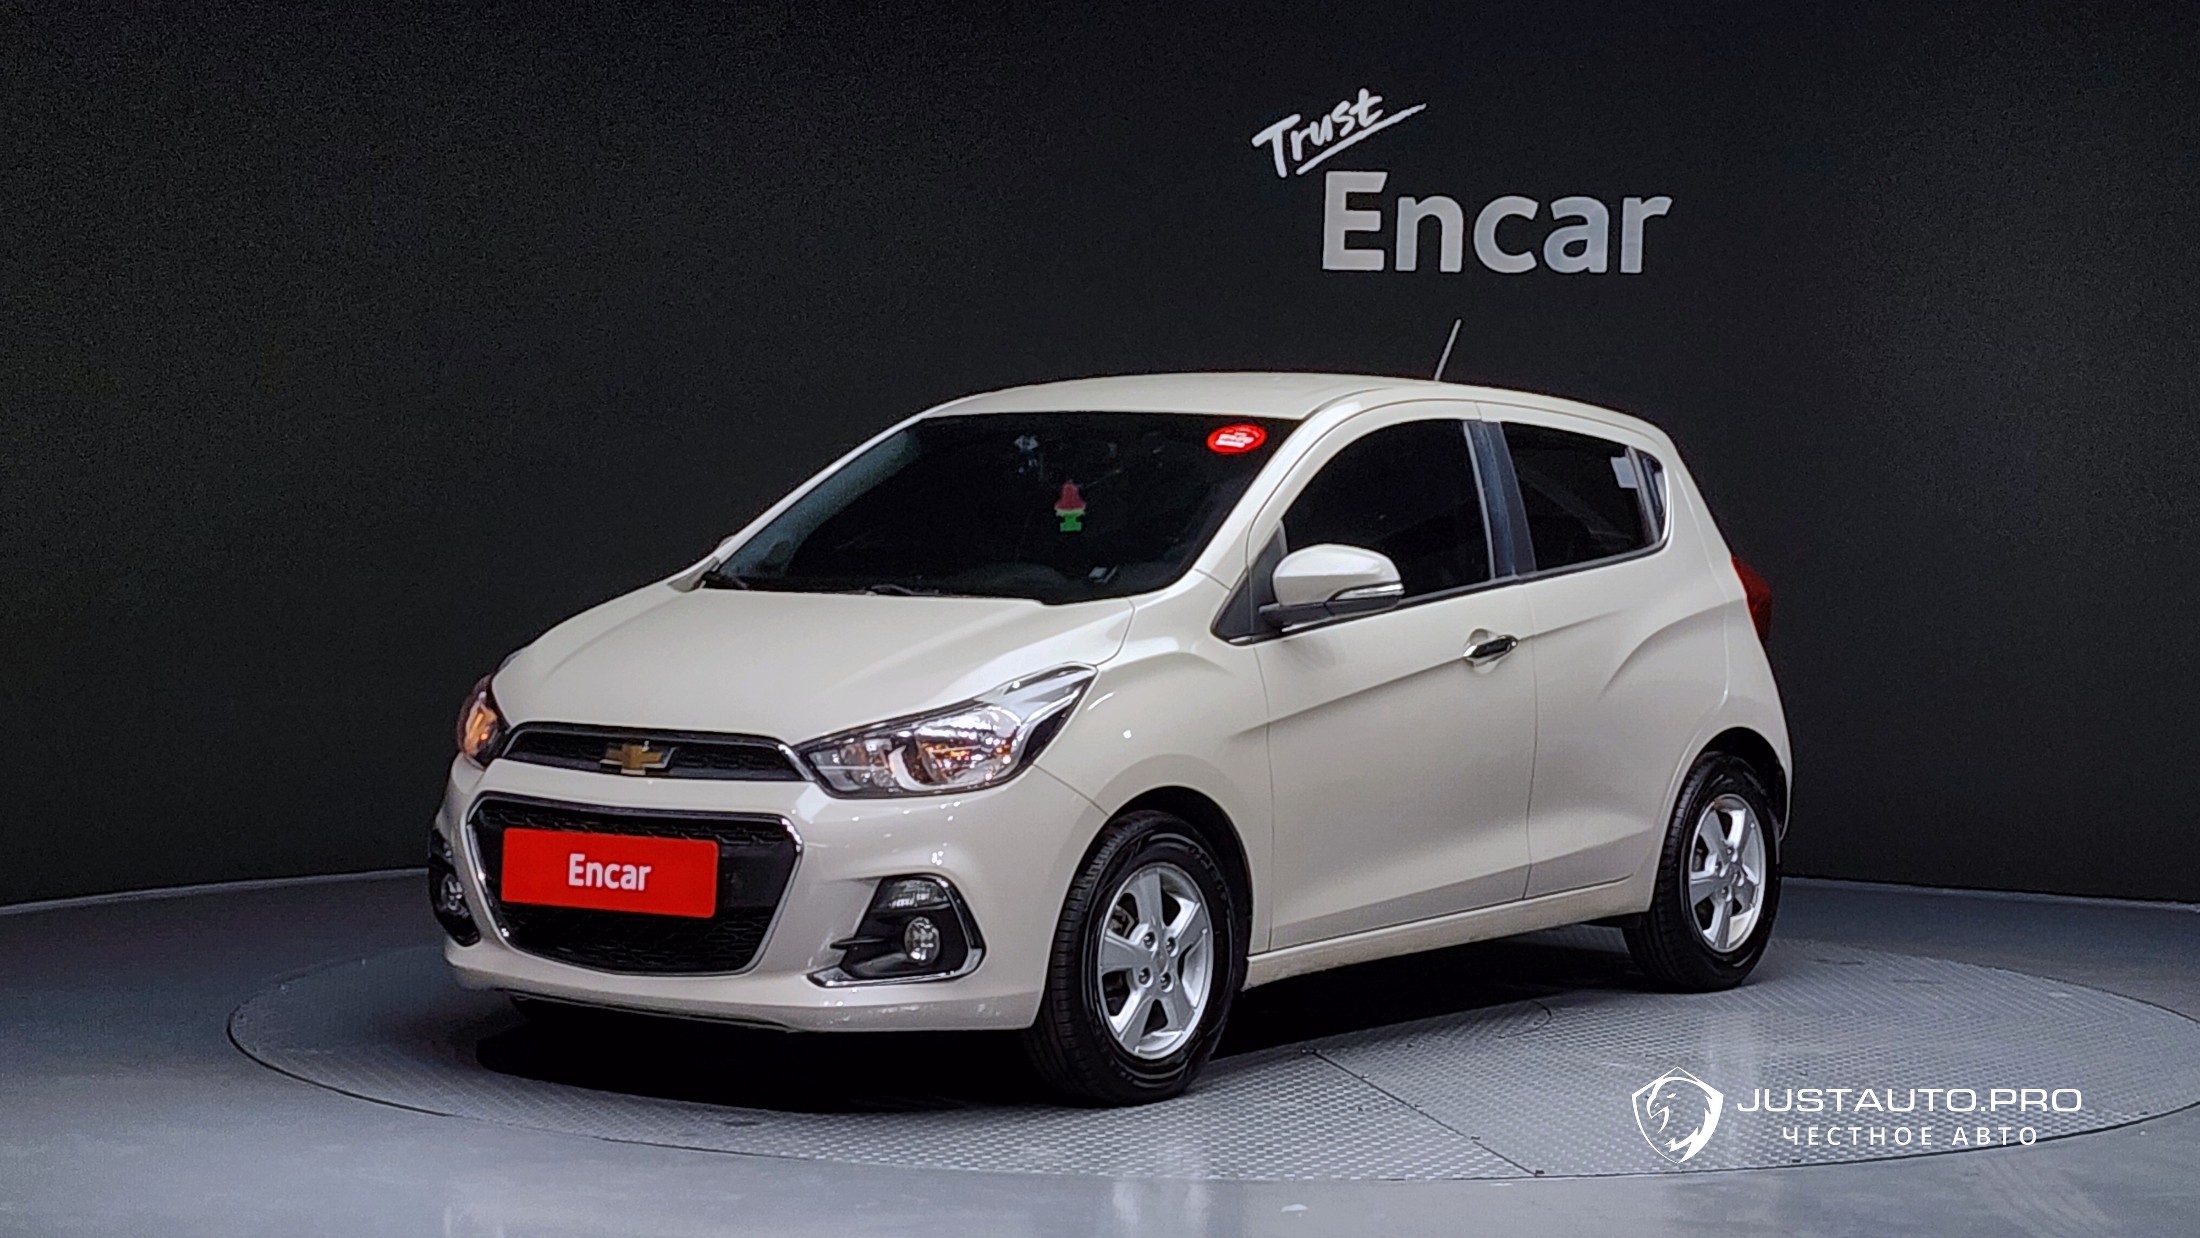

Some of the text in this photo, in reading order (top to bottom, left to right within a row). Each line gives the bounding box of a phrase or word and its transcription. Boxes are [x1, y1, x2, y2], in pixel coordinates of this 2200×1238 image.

[1252, 88, 1383, 178] Trust
[1322, 171, 1673, 273] Encar
[568, 853, 652, 891] Encar
